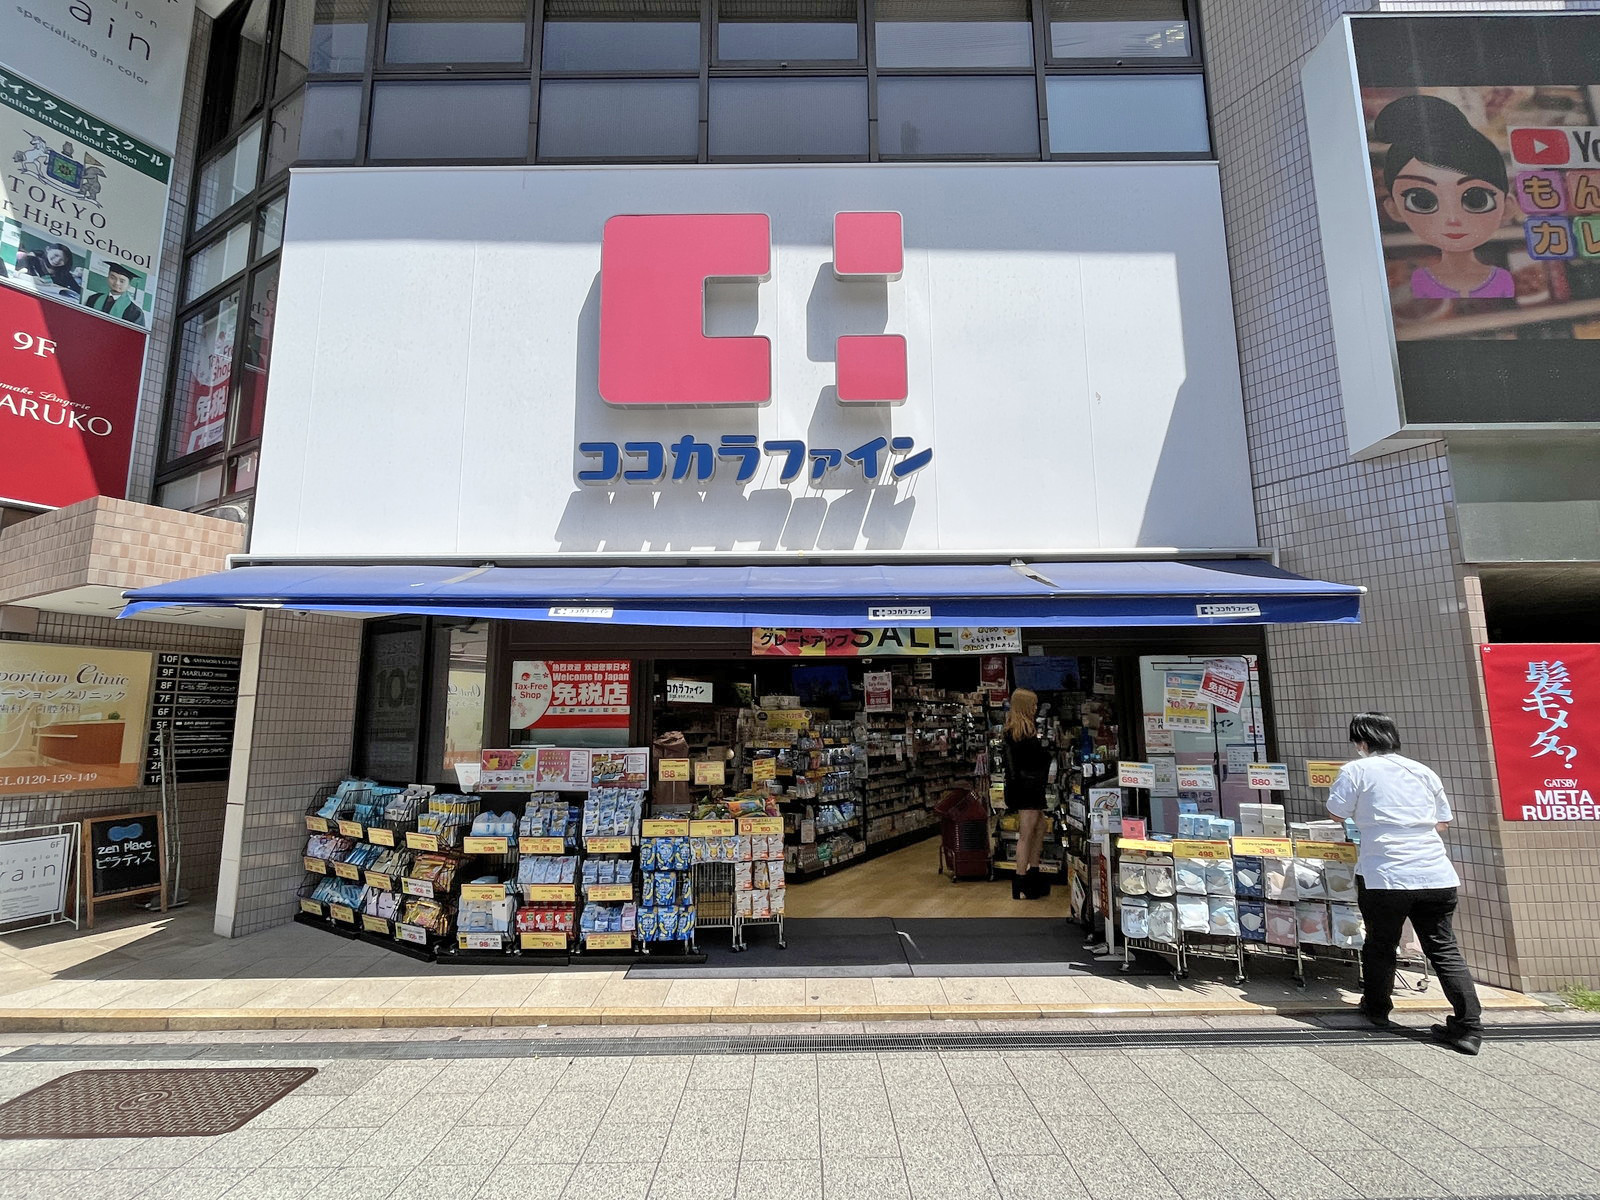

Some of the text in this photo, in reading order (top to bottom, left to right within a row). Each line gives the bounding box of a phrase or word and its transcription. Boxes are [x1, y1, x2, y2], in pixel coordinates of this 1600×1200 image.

[16, 5, 149, 85] specializing in color
[0, 92, 138, 166] Online International School
[8, 174, 107, 229] TOKYO
[83, 229, 151, 269] School
[13, 332, 57, 358] 9F
[0, 382, 91, 411] make Lingerie
[578, 434, 934, 486] ココカラファイン
[851, 628, 955, 649] SALE
[162, 655, 178, 663] 10F
[76, 663, 129, 686] Clinic
[162, 668, 174, 676] 9F
[552, 672, 629, 682] Welcome to Japan
[160, 682, 172, 690] 8F
[514, 682, 548, 691] Tax-Free
[1208, 681, 1238, 701] 免税店
[65, 690, 126, 701] クリニック
[160, 694, 171, 703] 7F
[520, 691, 541, 700] Shop
[552, 682, 628, 705] 免税店
[158, 708, 169, 716] 6F
[1521, 660, 1578, 769] 髪キメタ?
[156, 721, 168, 729] 5F
[661, 770, 675, 779] 188
[1312, 775, 1330, 784] 980
[1121, 776, 1139, 784] 698
[1252, 778, 1270, 786] 880
[1543, 778, 1578, 788] GATSBY
[1534, 790, 1595, 805] META
[98, 846, 119, 854] zen
[1259, 847, 1275, 855] 398
[96, 851, 155, 869] ピラティス
[1323, 852, 1340, 860] 478
